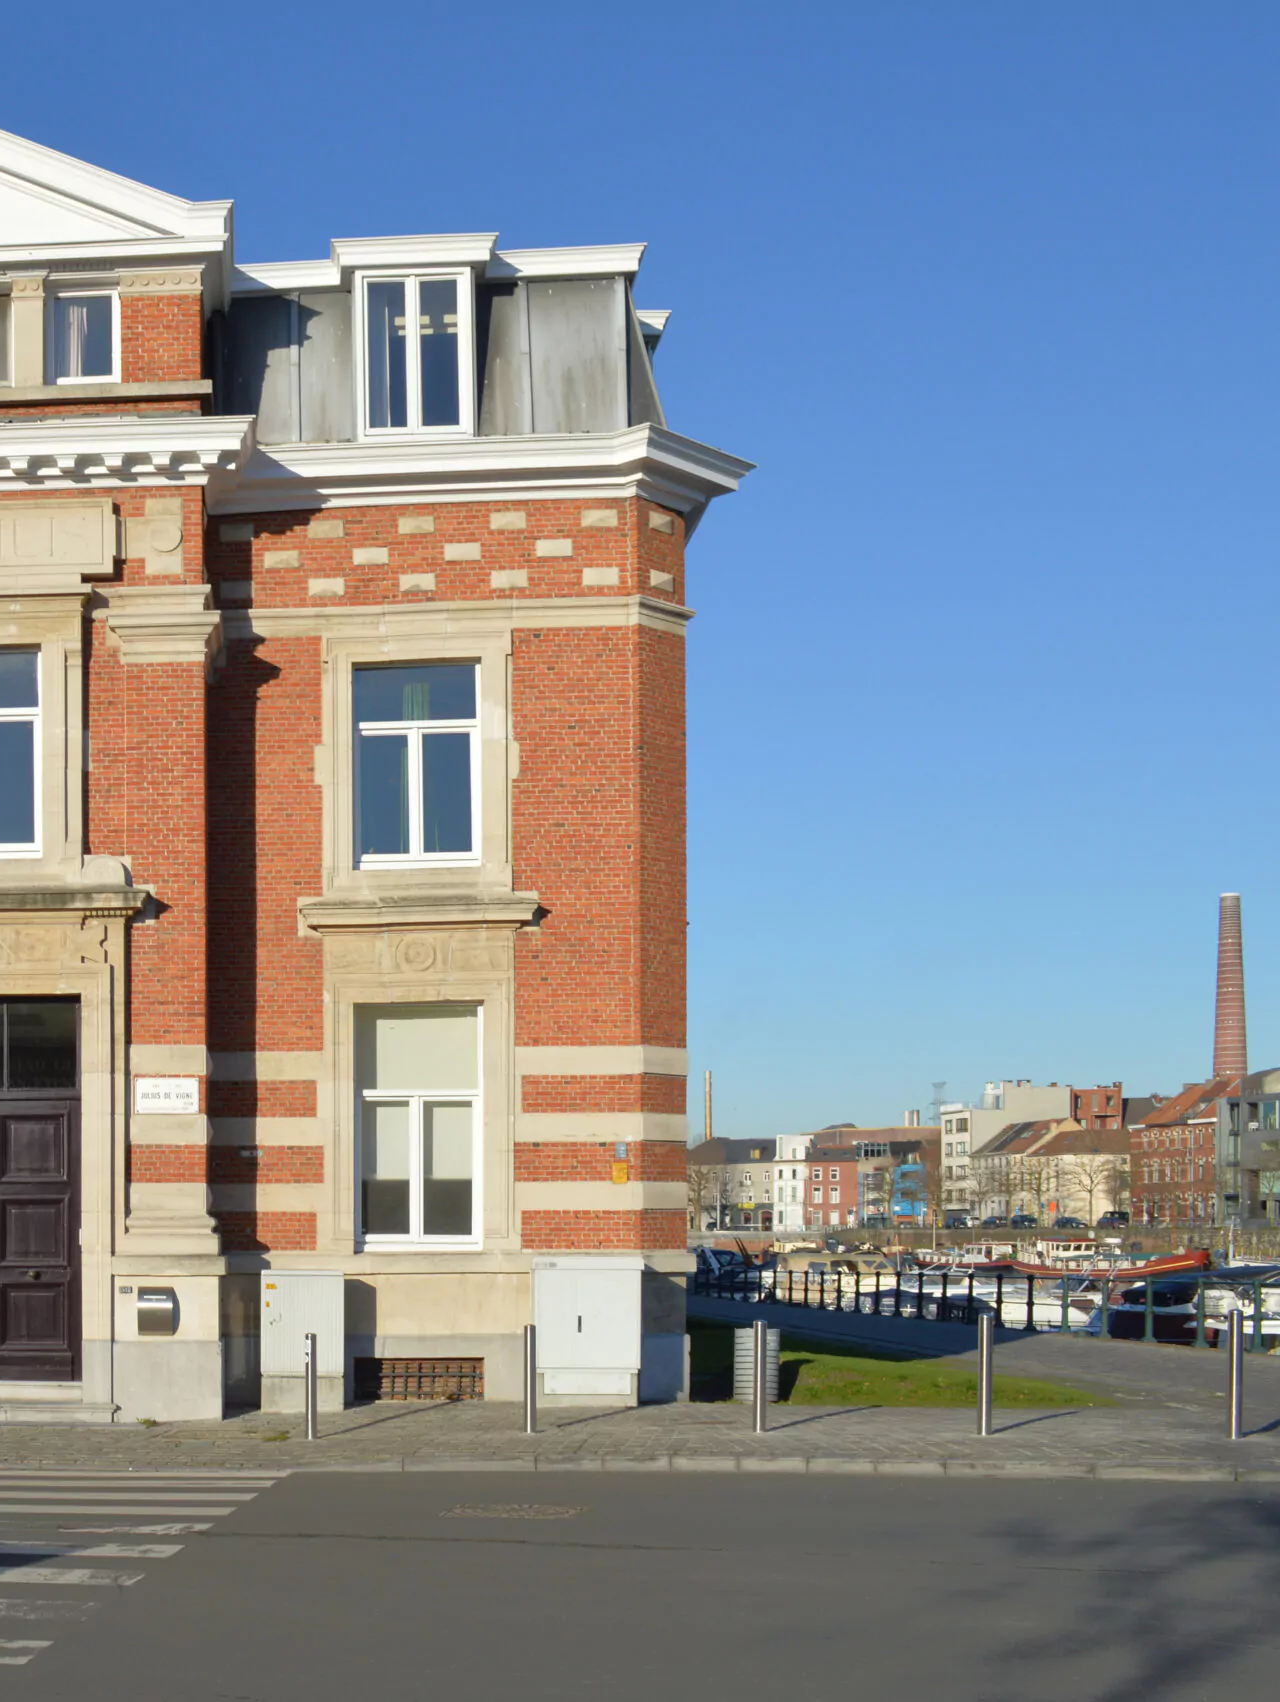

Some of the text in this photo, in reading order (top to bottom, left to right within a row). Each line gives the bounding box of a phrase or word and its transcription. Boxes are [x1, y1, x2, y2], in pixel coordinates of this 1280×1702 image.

[140, 1092, 193, 1100] JULIUS DE VIGNE
